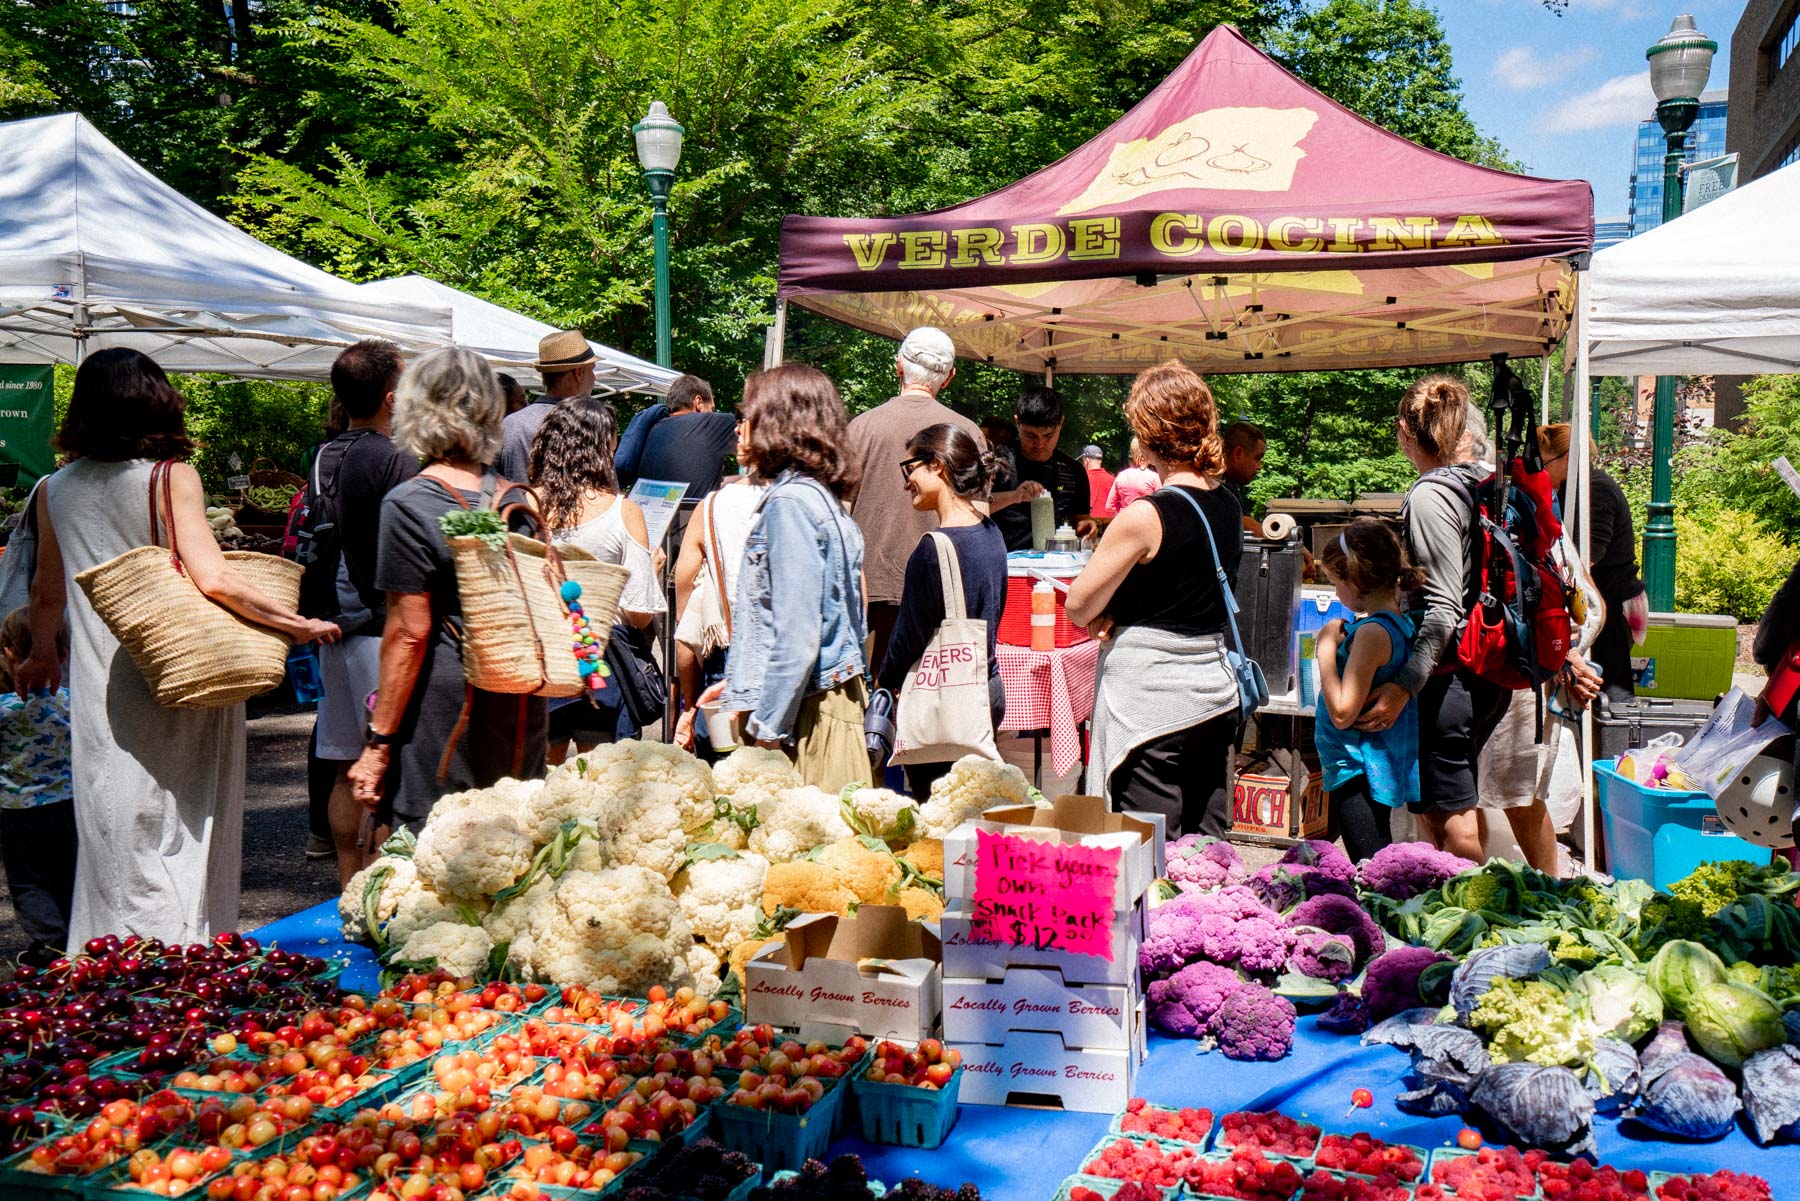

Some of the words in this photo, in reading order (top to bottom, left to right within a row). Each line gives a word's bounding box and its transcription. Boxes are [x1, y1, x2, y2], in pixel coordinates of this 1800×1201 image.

[1699, 181, 1724, 194] FREE
[842, 216, 1121, 272] VERDE
[1150, 212, 1511, 257] COCINA
[5, 380, 24, 390] since
[25, 381, 43, 390] 1980
[915, 667, 951, 687] OUT
[1233, 784, 1287, 828] RICH
[992, 843, 1051, 874] Pick
[1055, 855, 1110, 889] your
[977, 898, 1041, 922] Snack
[751, 980, 804, 999] Locally
[810, 986, 855, 1003] Grown
[861, 991, 911, 1009] Berries
[950, 996, 1007, 1014] Locally
[1013, 998, 1061, 1016] Grown
[1068, 1000, 1121, 1016] Berries
[961, 1062, 1005, 1080] ocally
[1009, 1062, 1058, 1079] Grown
[1064, 1065, 1117, 1082] Berries
